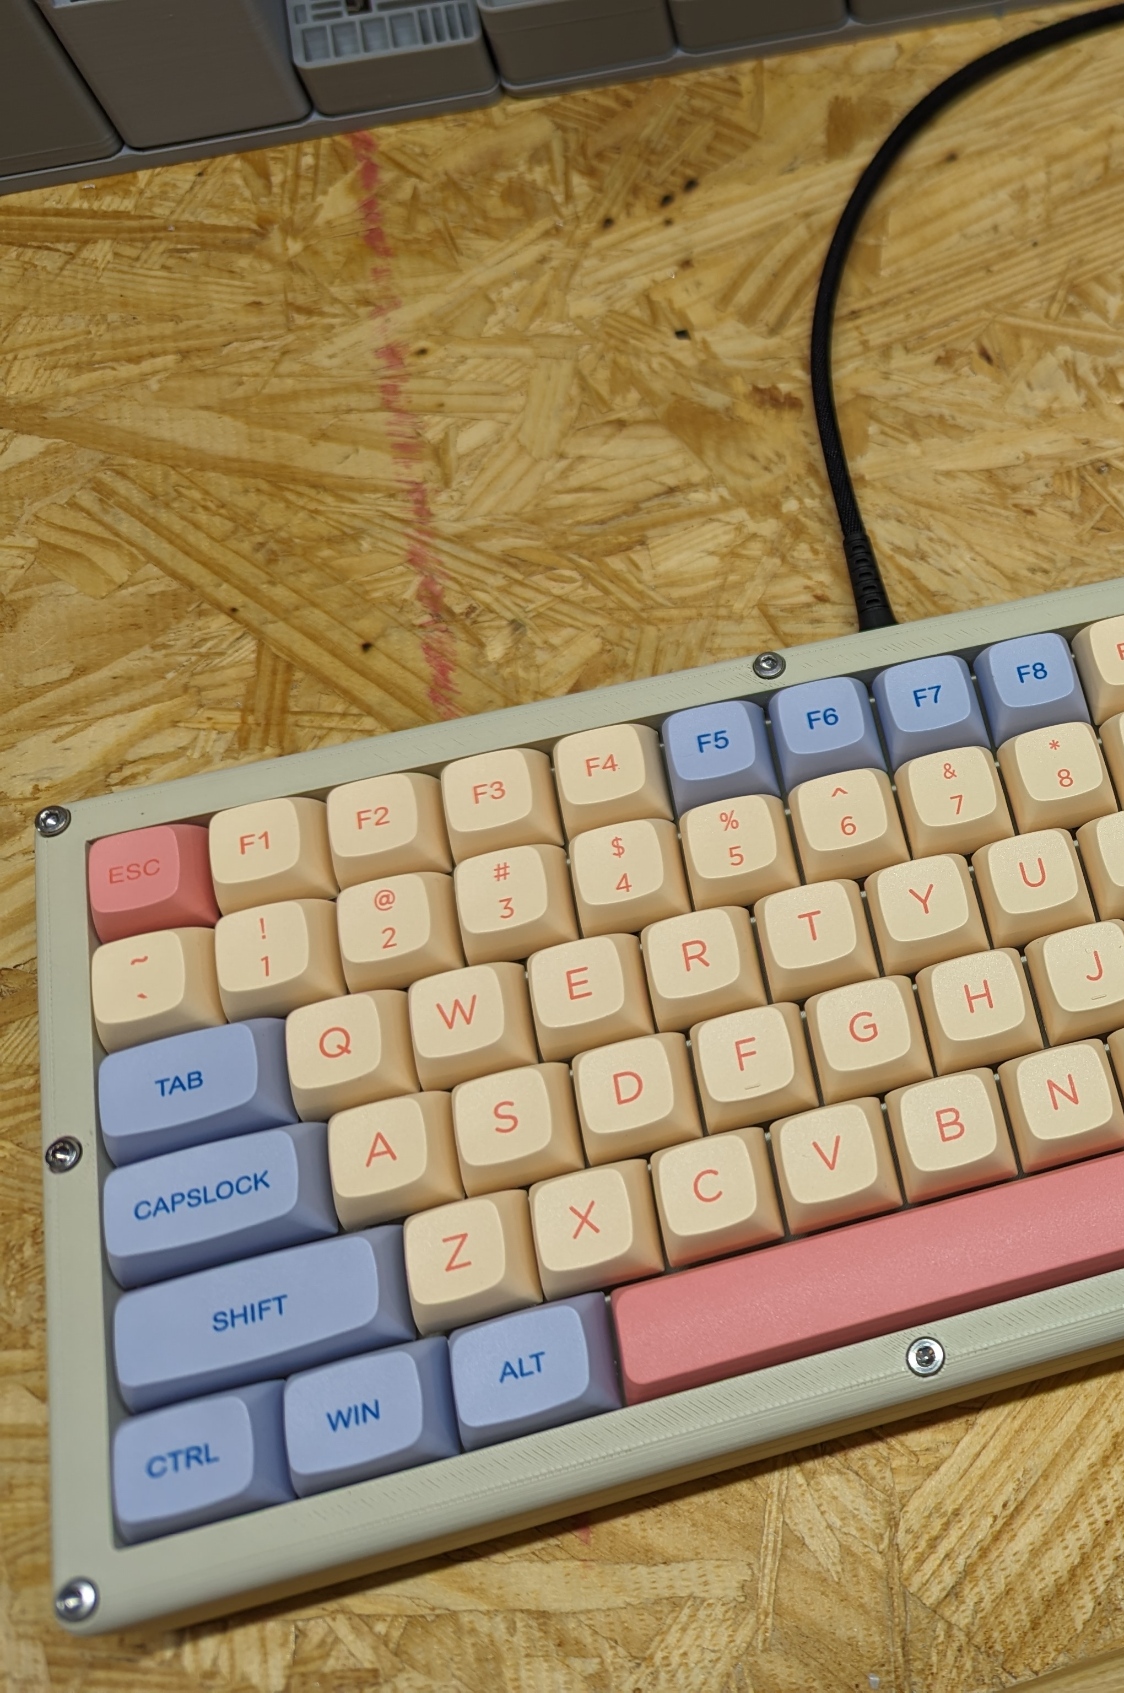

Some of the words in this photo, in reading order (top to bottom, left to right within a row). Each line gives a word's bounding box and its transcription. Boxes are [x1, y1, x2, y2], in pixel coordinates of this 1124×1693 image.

[1016, 661, 1048, 684] F8
[912, 684, 942, 708] F7
[806, 707, 839, 730] F6
[696, 729, 730, 754] F5
[585, 753, 619, 777] F4
[943, 762, 958, 780] &
[1057, 768, 1074, 788] 8
[472, 780, 506, 805] F3
[949, 794, 964, 815] 7
[356, 806, 391, 830] F2
[719, 809, 740, 832] %
[840, 815, 857, 836] 6
[239, 830, 270, 856] F1
[611, 836, 626, 859] $
[728, 845, 744, 867] 5
[108, 858, 161, 885] ESC
[493, 861, 511, 882] #
[615, 872, 633, 893] 4
[1018, 857, 1047, 888] U
[373, 889, 396, 912] @
[498, 897, 515, 919] 3
[908, 883, 934, 915] Y
[259, 917, 267, 940] !
[381, 926, 398, 950] 2
[797, 909, 822, 941] T
[260, 955, 270, 977] 1
[681, 939, 710, 972] R
[1085, 950, 1104, 982] J
[565, 966, 593, 1001] E
[963, 978, 994, 1014] H
[435, 994, 477, 1030] W
[848, 1011, 879, 1043] G
[318, 1026, 352, 1059] Q
[734, 1036, 757, 1072] F
[154, 1070, 204, 1097] TAB
[612, 1070, 644, 1106] D
[1046, 1073, 1080, 1111] N
[493, 1100, 519, 1134] S
[935, 1107, 965, 1143] B
[365, 1131, 398, 1168] A
[811, 1135, 841, 1171] V
[133, 1169, 271, 1221] CAPSLOCK
[693, 1168, 723, 1203] C
[568, 1200, 601, 1240] X
[441, 1232, 472, 1273] Z
[212, 1294, 288, 1333] SHIFT
[499, 1351, 546, 1384] ALT
[326, 1399, 381, 1432] WIN
[146, 1443, 219, 1479] CTRL
